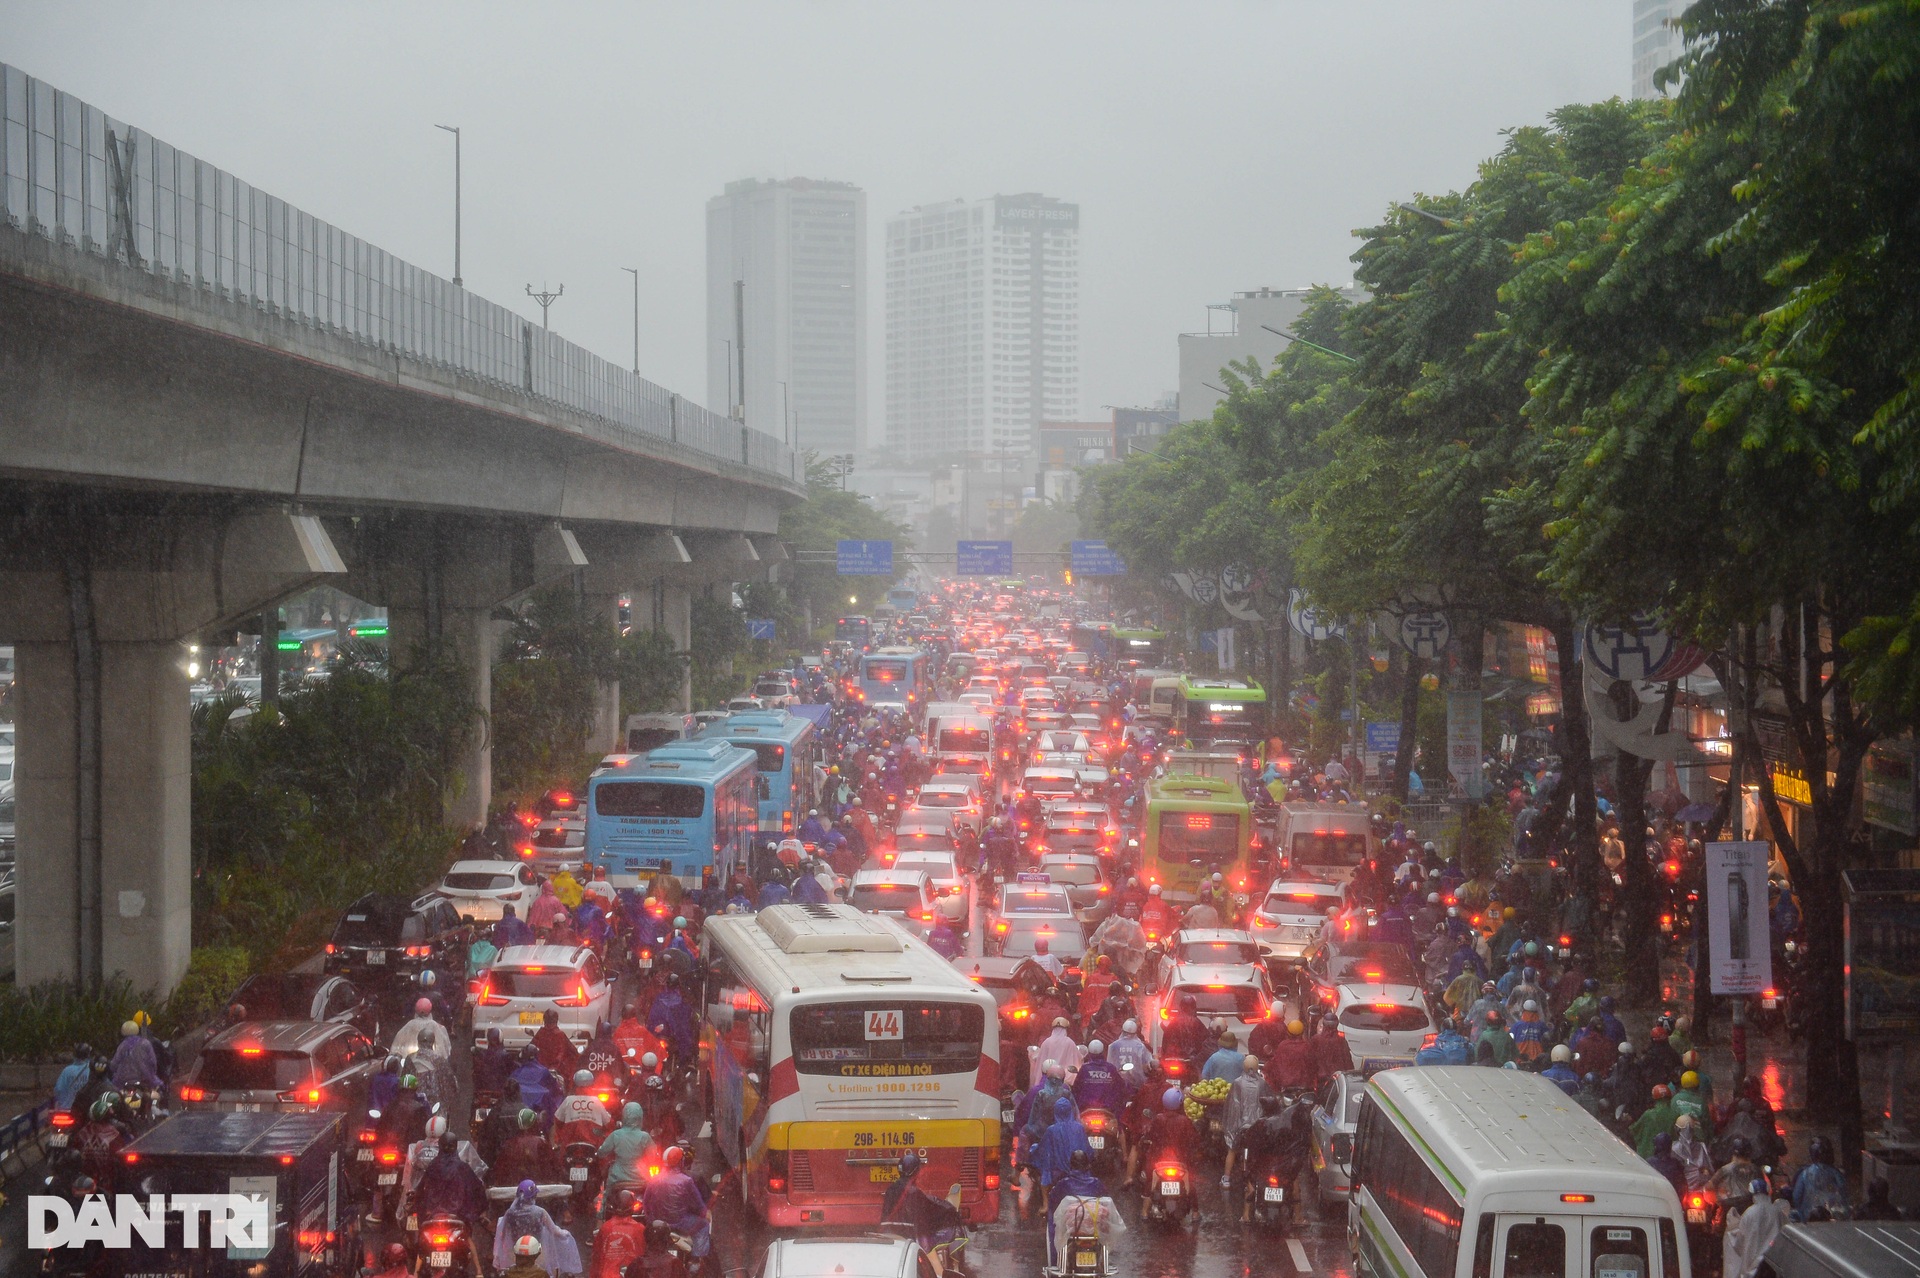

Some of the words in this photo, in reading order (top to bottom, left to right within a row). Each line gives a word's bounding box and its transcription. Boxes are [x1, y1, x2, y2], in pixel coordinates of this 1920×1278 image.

[868, 1012, 899, 1037] 44
[588, 1052, 605, 1062] ON
[588, 1061, 608, 1071] OFF
[841, 1065, 856, 1076] CT
[858, 1065, 870, 1075] XE
[839, 1083, 873, 1093] Hotline
[876, 1082, 941, 1092] 1900.1296
[881, 1132, 915, 1146] 114.96
[848, 1148, 927, 1158] DAEWOO
